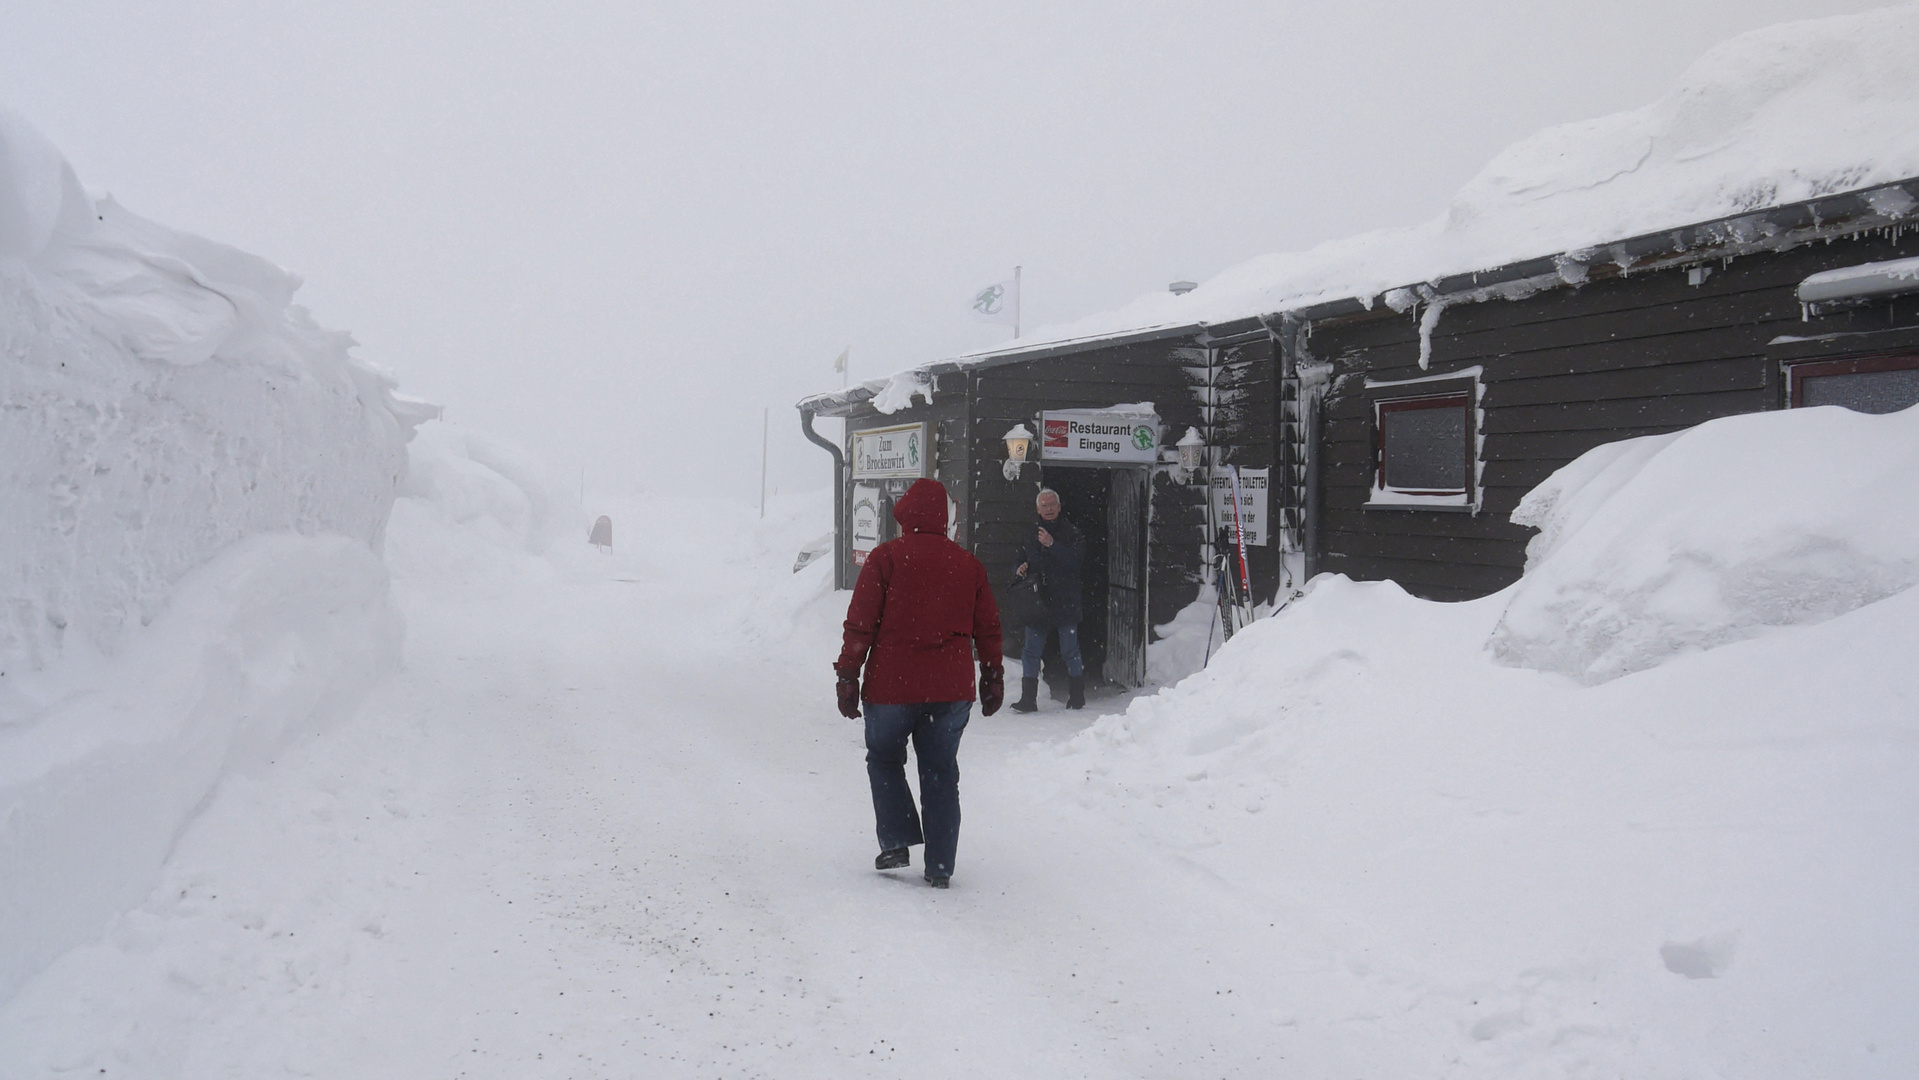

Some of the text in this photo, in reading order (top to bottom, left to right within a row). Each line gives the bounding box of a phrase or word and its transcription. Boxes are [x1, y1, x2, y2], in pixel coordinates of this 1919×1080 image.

[1069, 421, 1131, 436] Restaurant
[878, 436, 892, 452] Zum
[1079, 438, 1120, 453] Eingang
[866, 453, 905, 470] Brockenwirt
[1242, 477, 1268, 489] TOILETTEN
[1244, 494, 1253, 505] sich
[1221, 510, 1232, 522] links
[1247, 511, 1255, 523] der
[1238, 521, 1246, 560] ATOMIC
